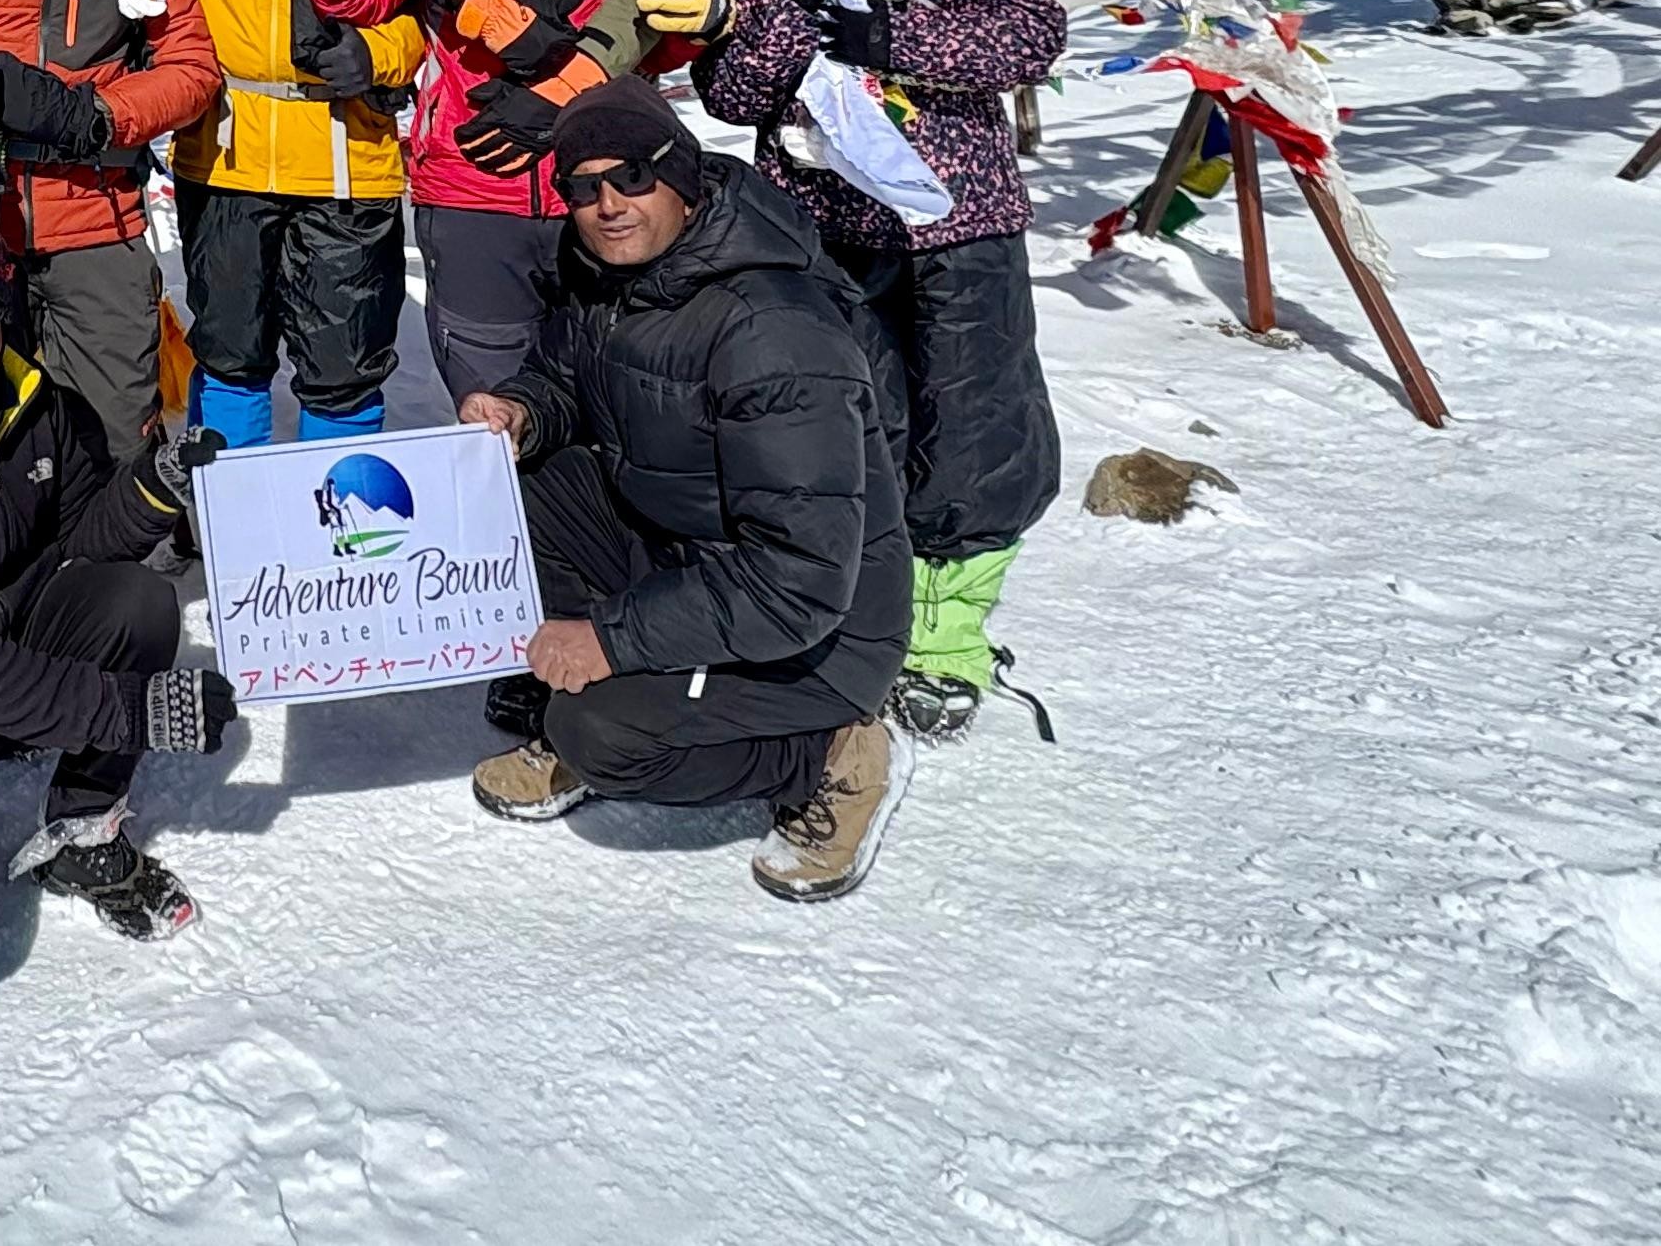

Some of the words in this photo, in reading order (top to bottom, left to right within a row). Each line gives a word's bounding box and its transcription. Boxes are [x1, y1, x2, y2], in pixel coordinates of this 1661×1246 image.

[224, 563, 401, 627] Adventure
[408, 536, 522, 609] Bound
[240, 624, 372, 655] Private
[397, 601, 528, 635] Limited
[239, 634, 529, 696] アドベンチャーバウンド
